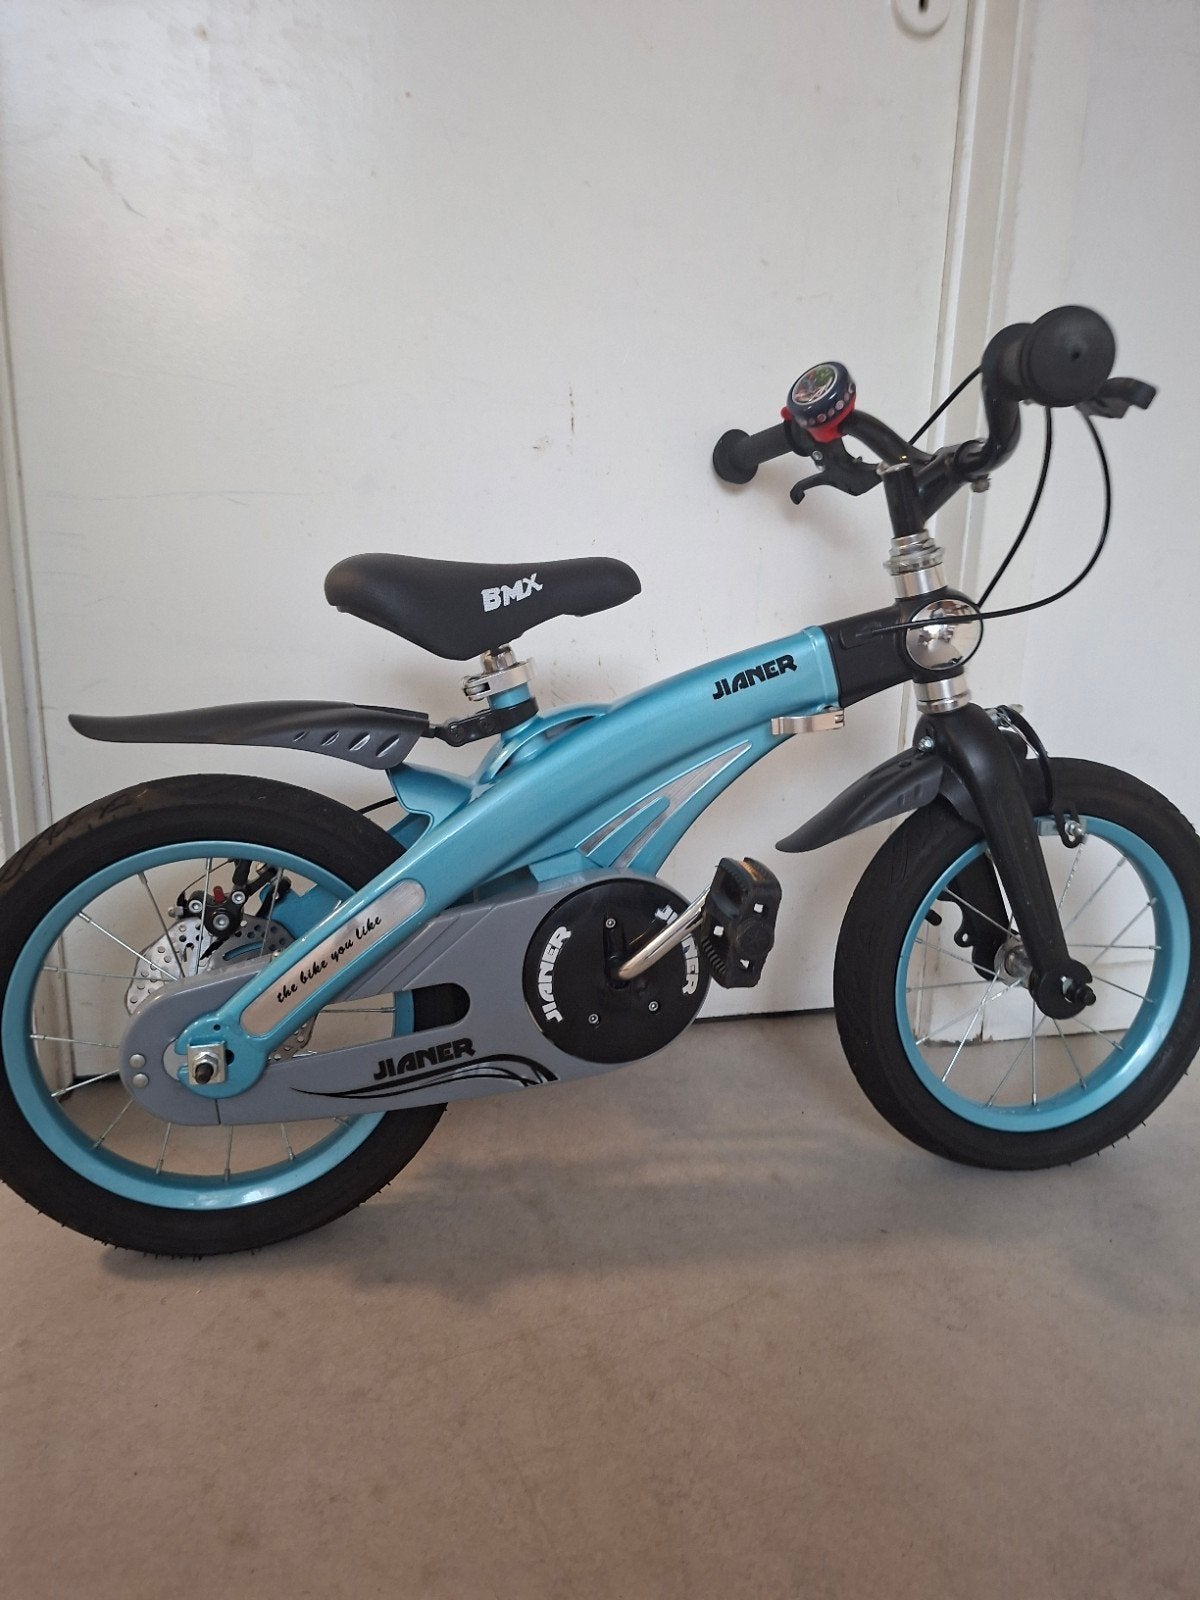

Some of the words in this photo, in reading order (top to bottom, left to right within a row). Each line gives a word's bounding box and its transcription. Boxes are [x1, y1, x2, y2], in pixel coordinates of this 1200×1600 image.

[481, 572, 543, 612] BMX
[712, 654, 798, 700] JIANER
[277, 983, 298, 1003] the
[300, 960, 328, 984] bike
[331, 939, 354, 962] you
[355, 916, 382, 940] like
[538, 926, 572, 1023] JIANER
[654, 904, 700, 995] JINER
[373, 1037, 476, 1081] JIANER
